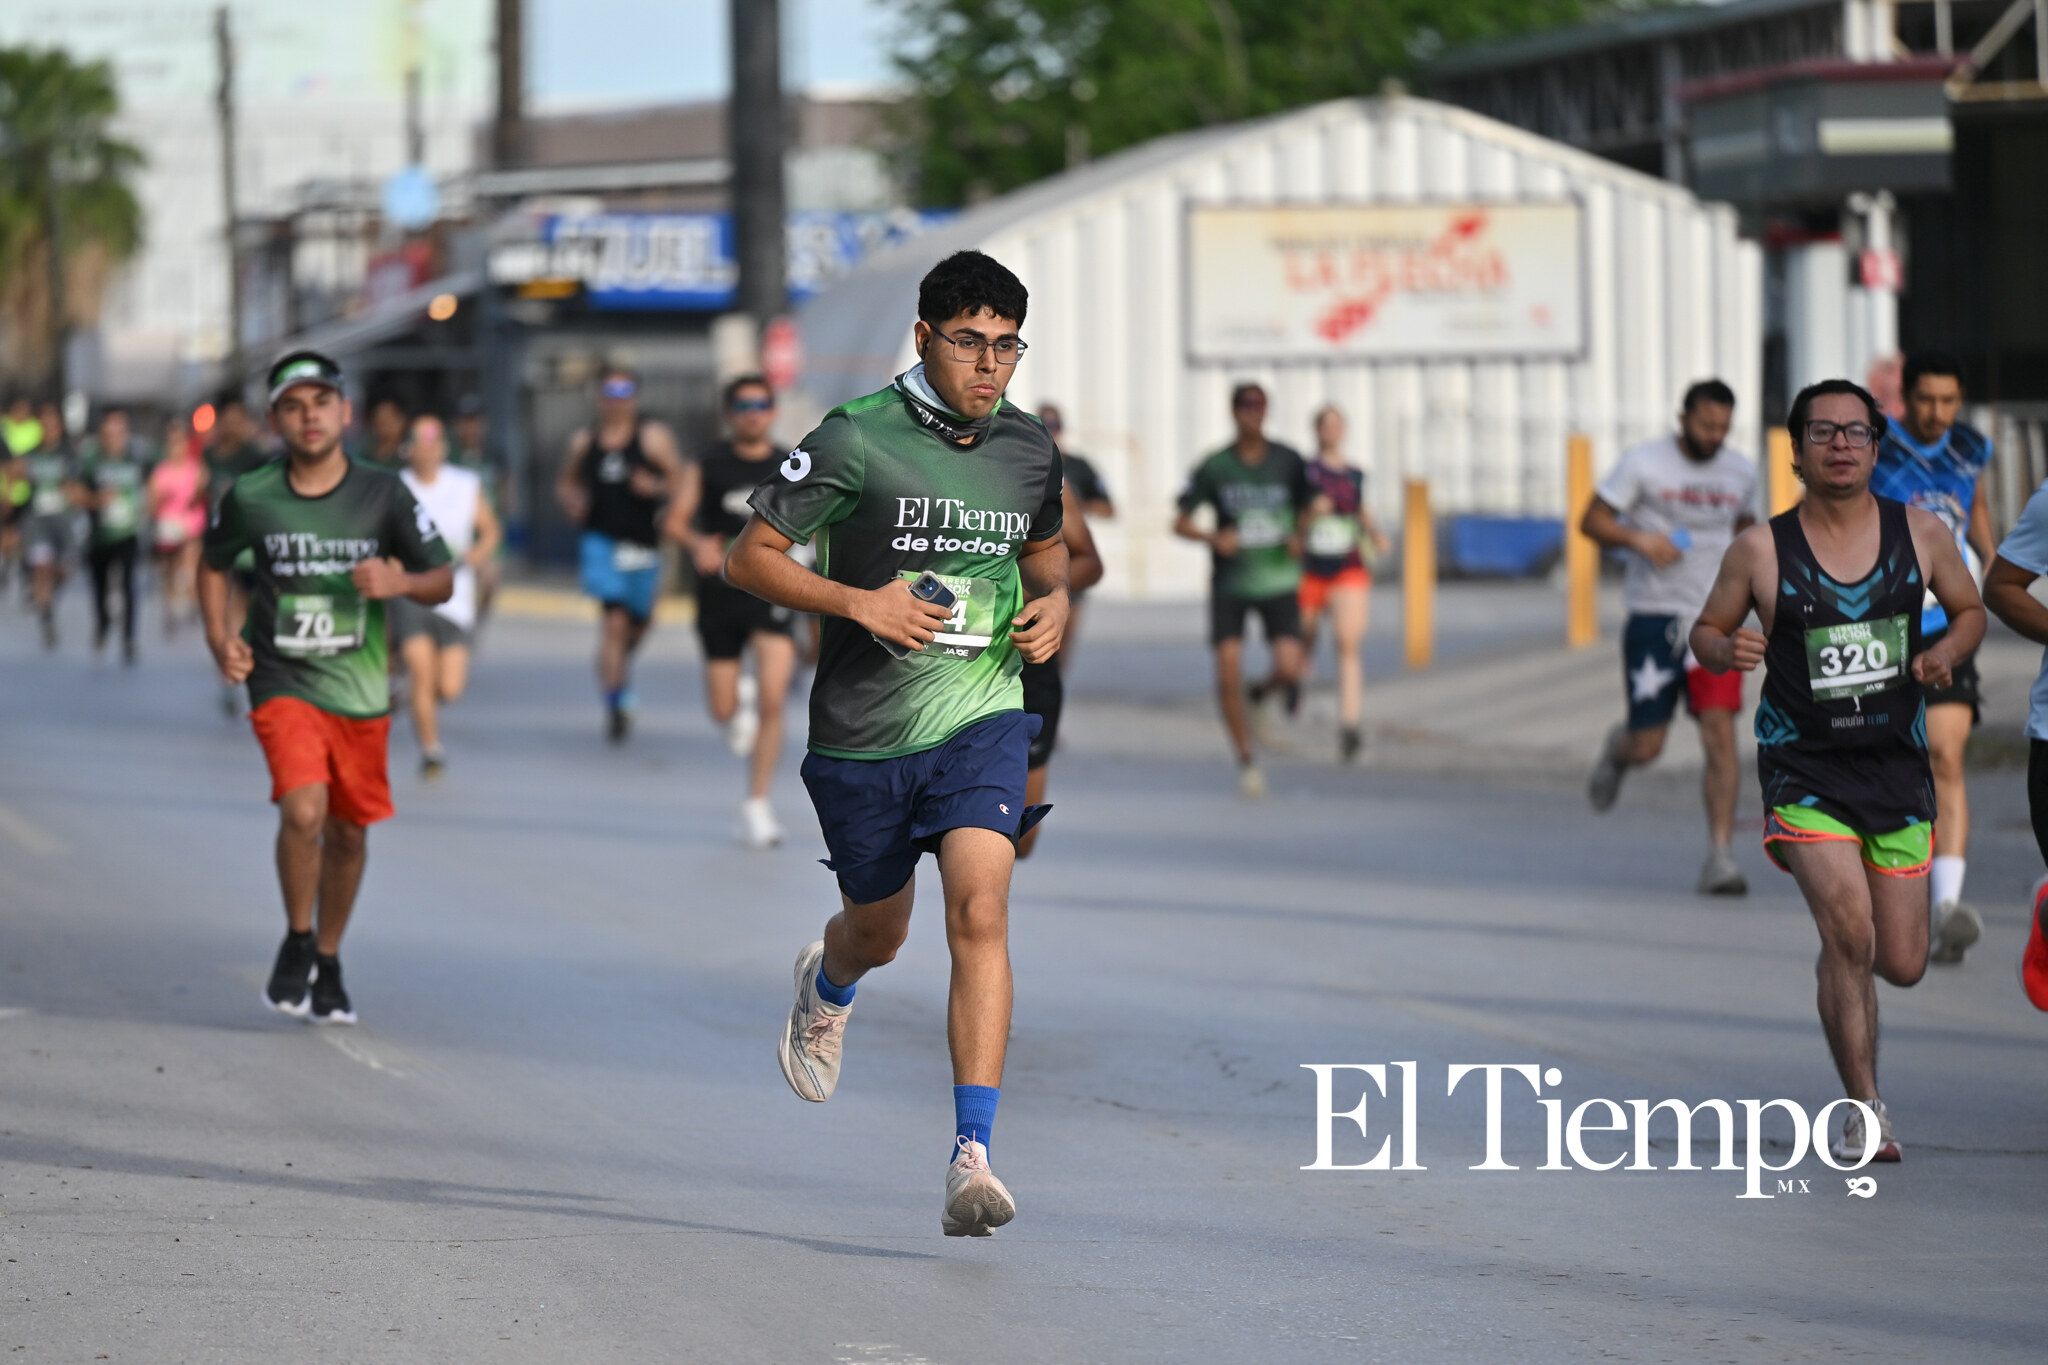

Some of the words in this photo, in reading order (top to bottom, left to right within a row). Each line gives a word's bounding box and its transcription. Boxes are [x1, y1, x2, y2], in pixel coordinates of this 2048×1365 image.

[894, 497, 929, 528] El
[936, 498, 1030, 541] Tiempo
[891, 533, 929, 551] de
[934, 535, 1011, 556] todos
[293, 612, 335, 638] 70
[1819, 639, 1888, 677] 320
